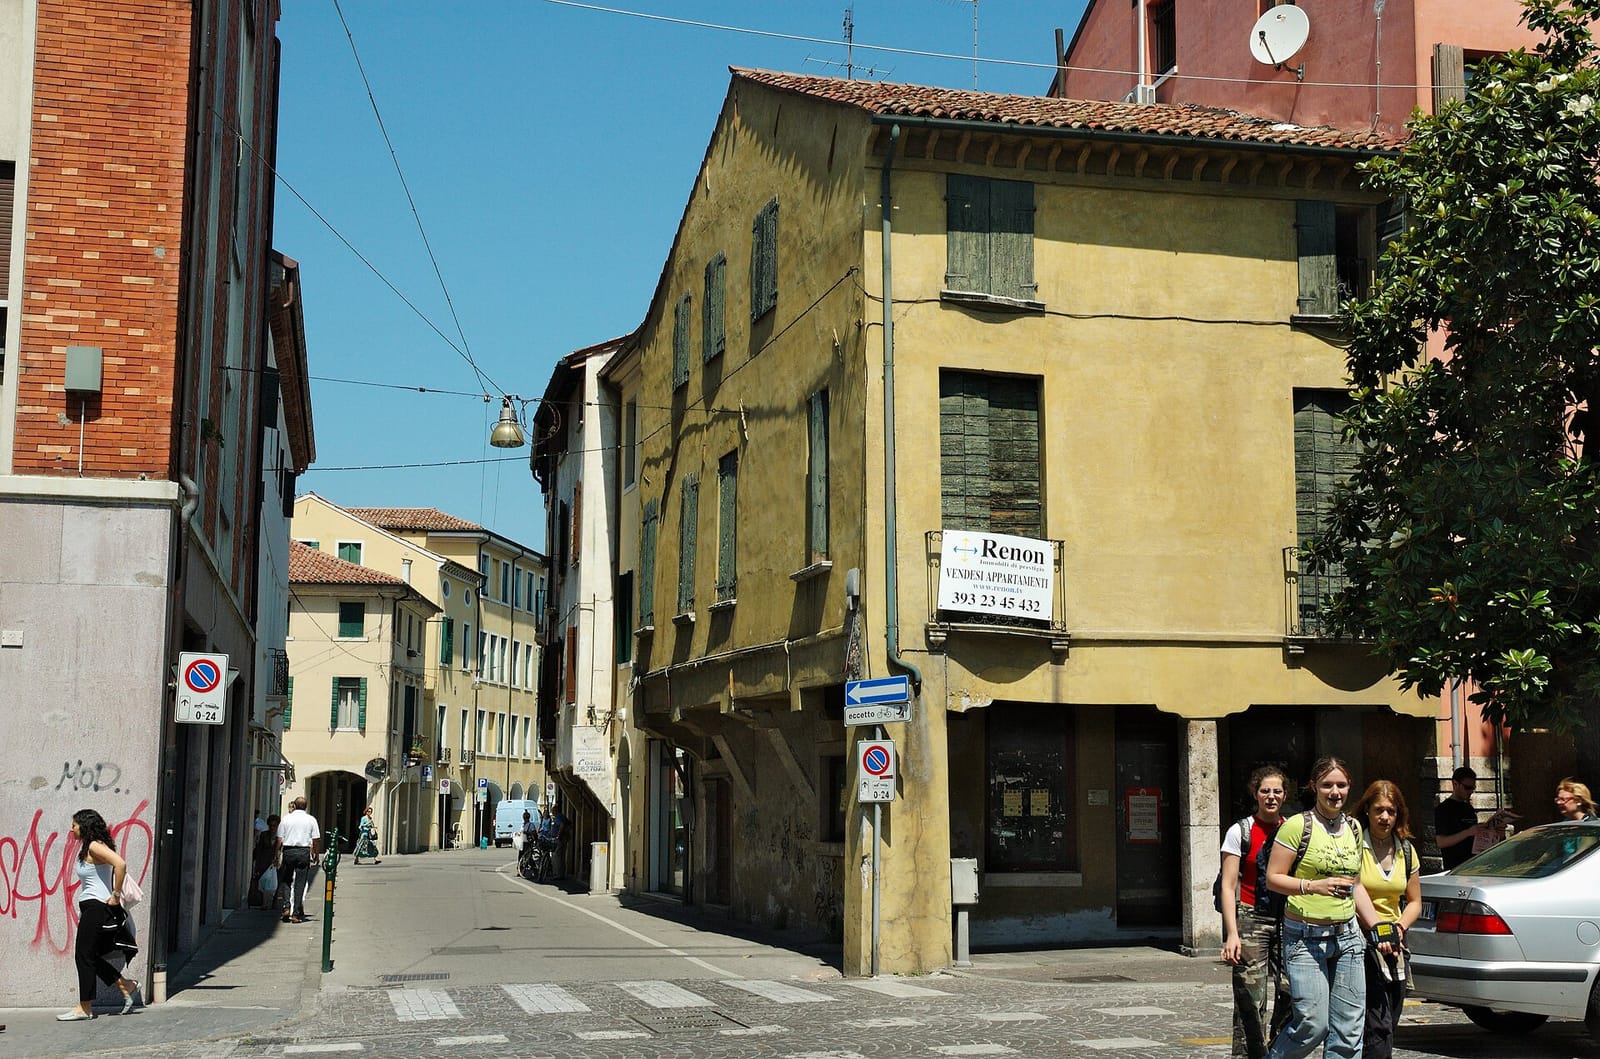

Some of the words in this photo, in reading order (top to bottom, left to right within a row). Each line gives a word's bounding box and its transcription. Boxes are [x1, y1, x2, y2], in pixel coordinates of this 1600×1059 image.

[981, 539, 1044, 564] Renon
[946, 567, 984, 581] VENDESI
[986, 572, 1048, 589] APPARTAMENTI
[952, 592, 976, 606] 393
[980, 594, 996, 608] 23
[999, 596, 1015, 609] 45
[1018, 599, 1040, 613] 432
[195, 710, 216, 721] 0-24
[848, 711, 875, 720] eccetto
[479, 779, 486, 787] P
[873, 790, 890, 799] 0-24
